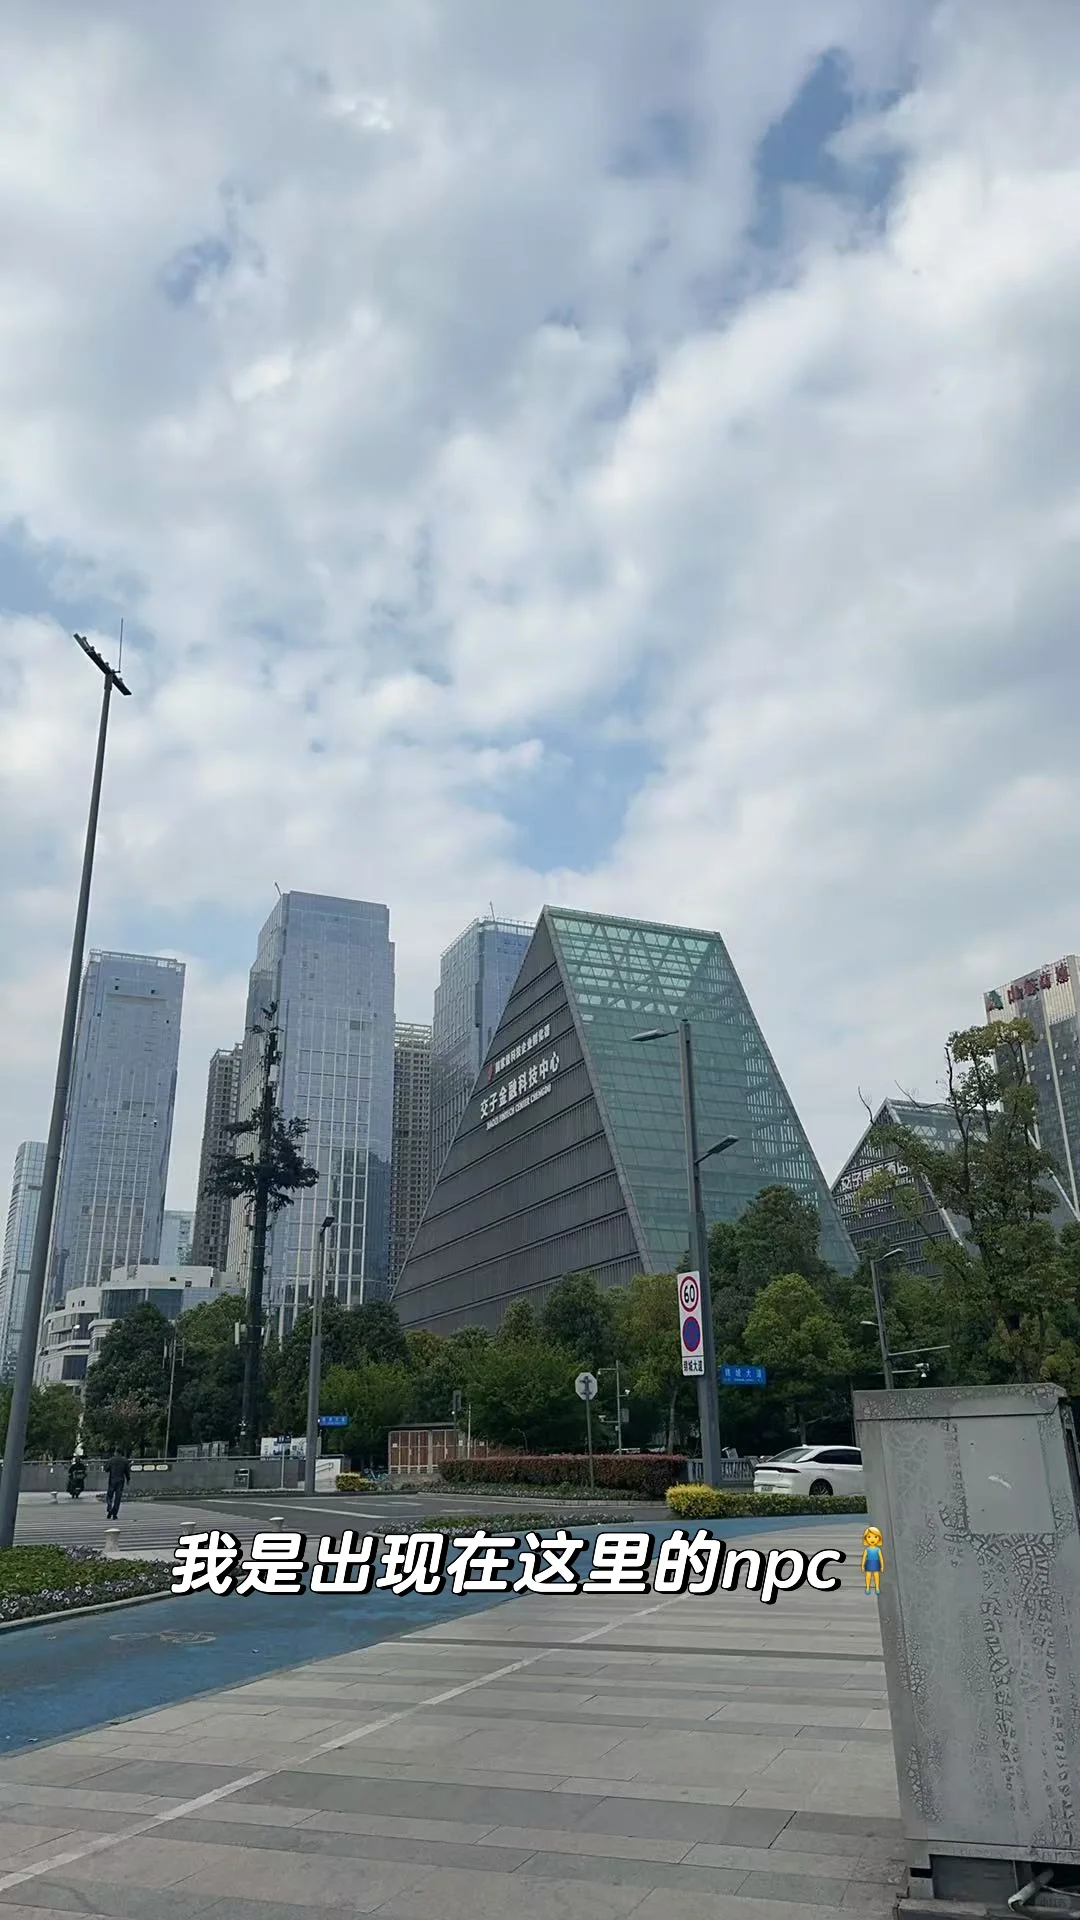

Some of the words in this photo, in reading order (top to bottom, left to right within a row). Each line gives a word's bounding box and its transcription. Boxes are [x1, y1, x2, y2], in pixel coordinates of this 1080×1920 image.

[480, 1051, 560, 1119] 交子金融科技中心
[684, 1285, 695, 1303] 60
